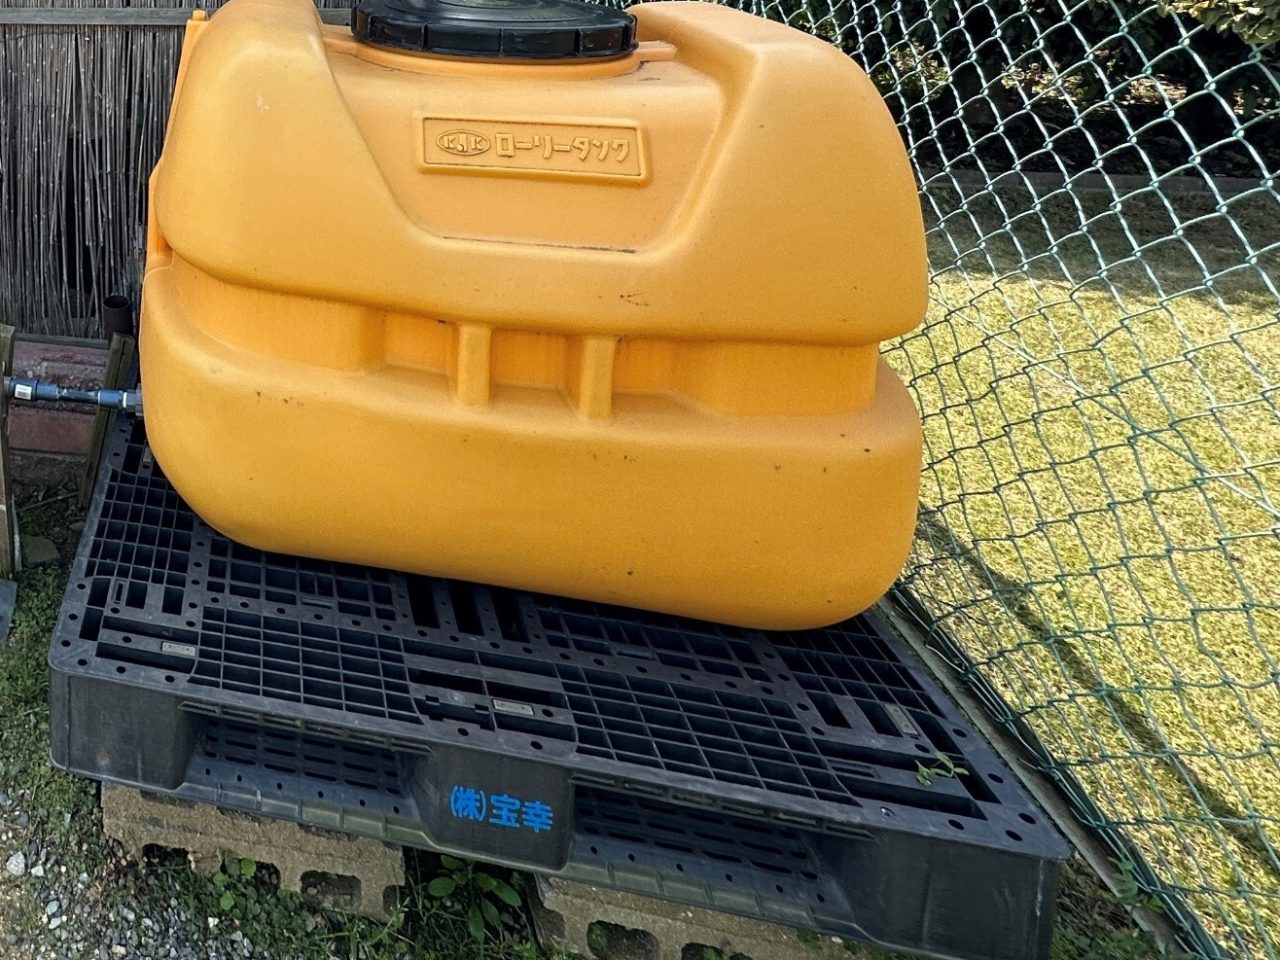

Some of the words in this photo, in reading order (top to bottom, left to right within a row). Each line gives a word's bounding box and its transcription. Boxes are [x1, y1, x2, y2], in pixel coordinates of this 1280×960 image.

[495, 132, 630, 162] ローリータンク
